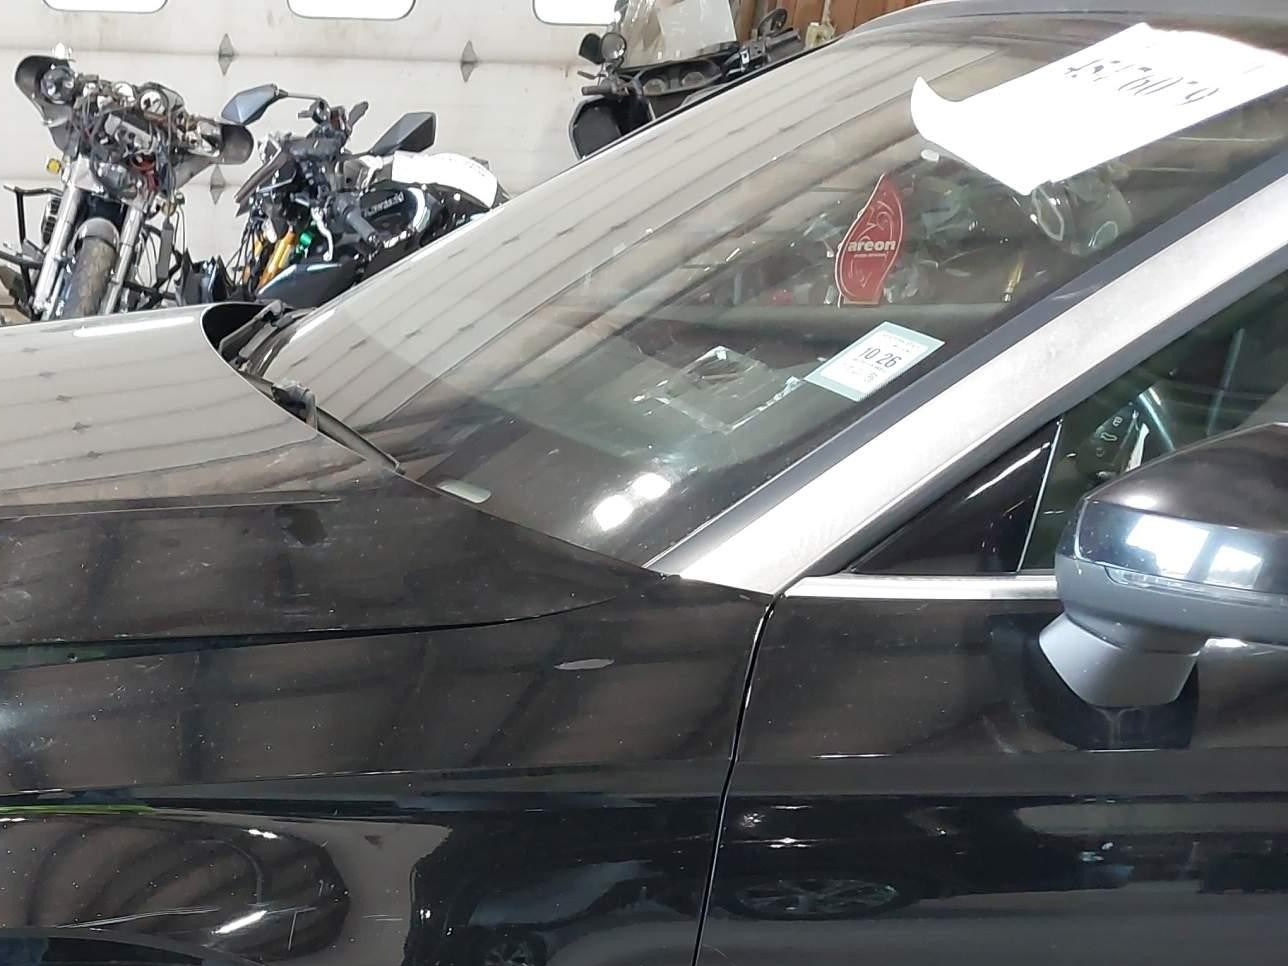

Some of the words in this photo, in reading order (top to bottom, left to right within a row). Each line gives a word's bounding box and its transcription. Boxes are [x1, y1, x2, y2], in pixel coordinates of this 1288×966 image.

[847, 240, 896, 252] areon
[858, 346, 881, 361] 10
[875, 352, 902, 369] 26
